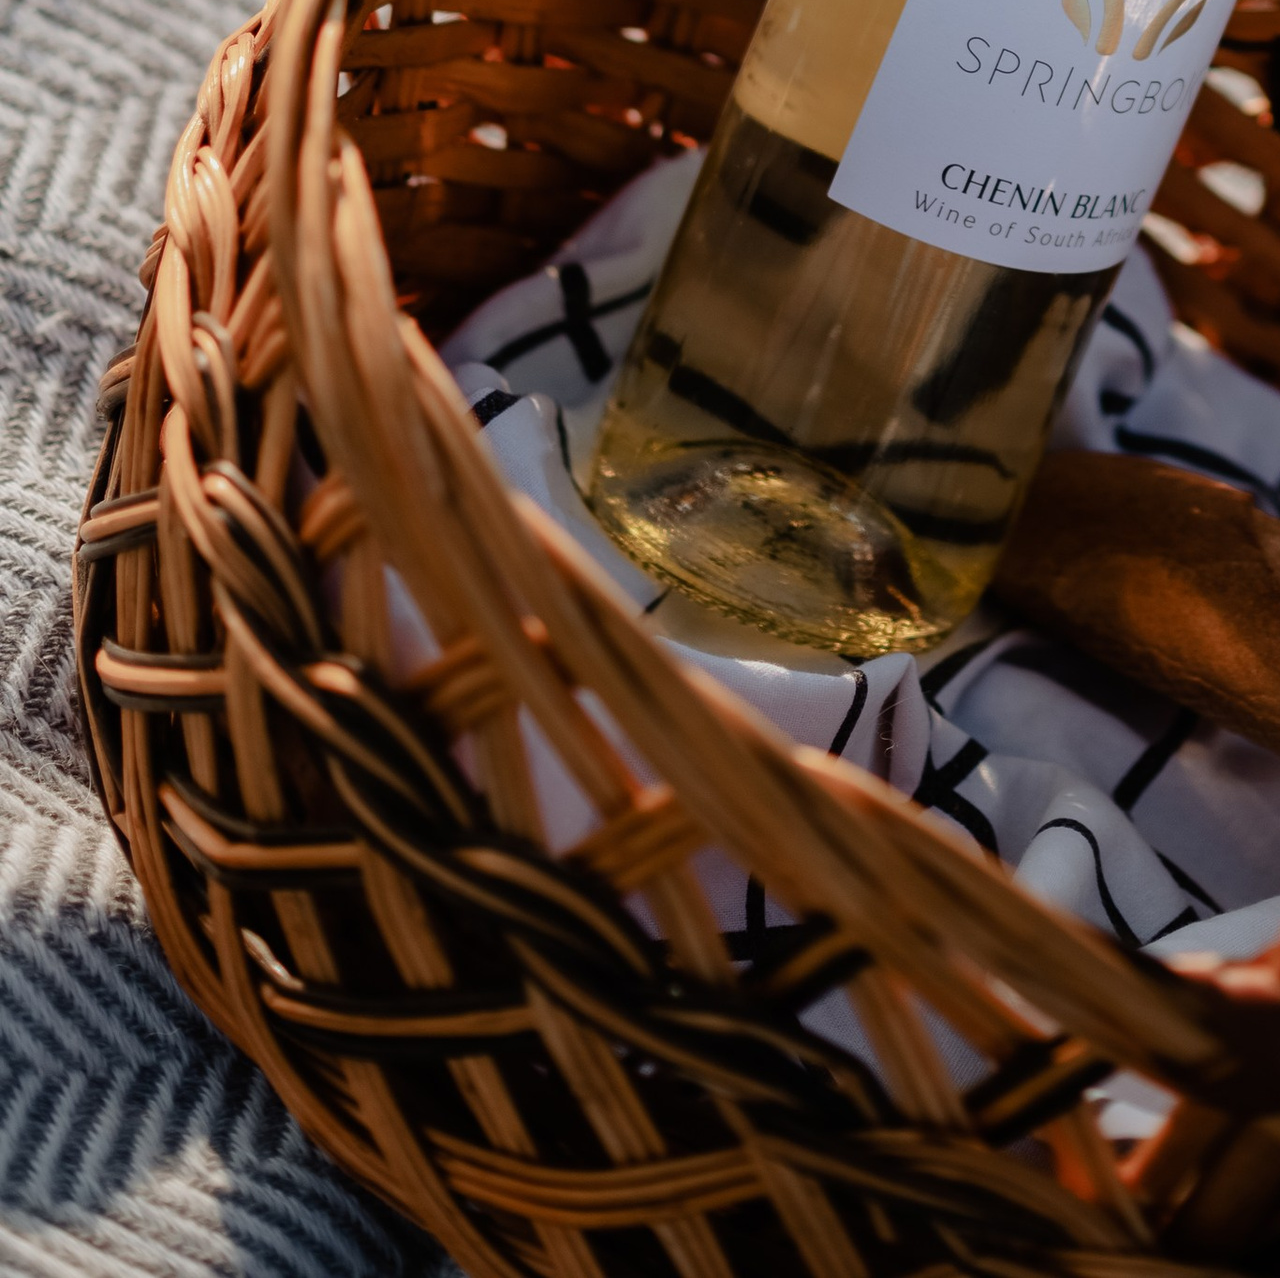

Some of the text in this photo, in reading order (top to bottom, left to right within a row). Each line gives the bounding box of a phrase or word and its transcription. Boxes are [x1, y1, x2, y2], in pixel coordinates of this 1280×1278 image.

[914, 190, 976, 229] Wine
[989, 221, 1017, 239] of
[1024, 226, 1085, 248] South
[941, 163, 1146, 219] CHENIN BLANC
